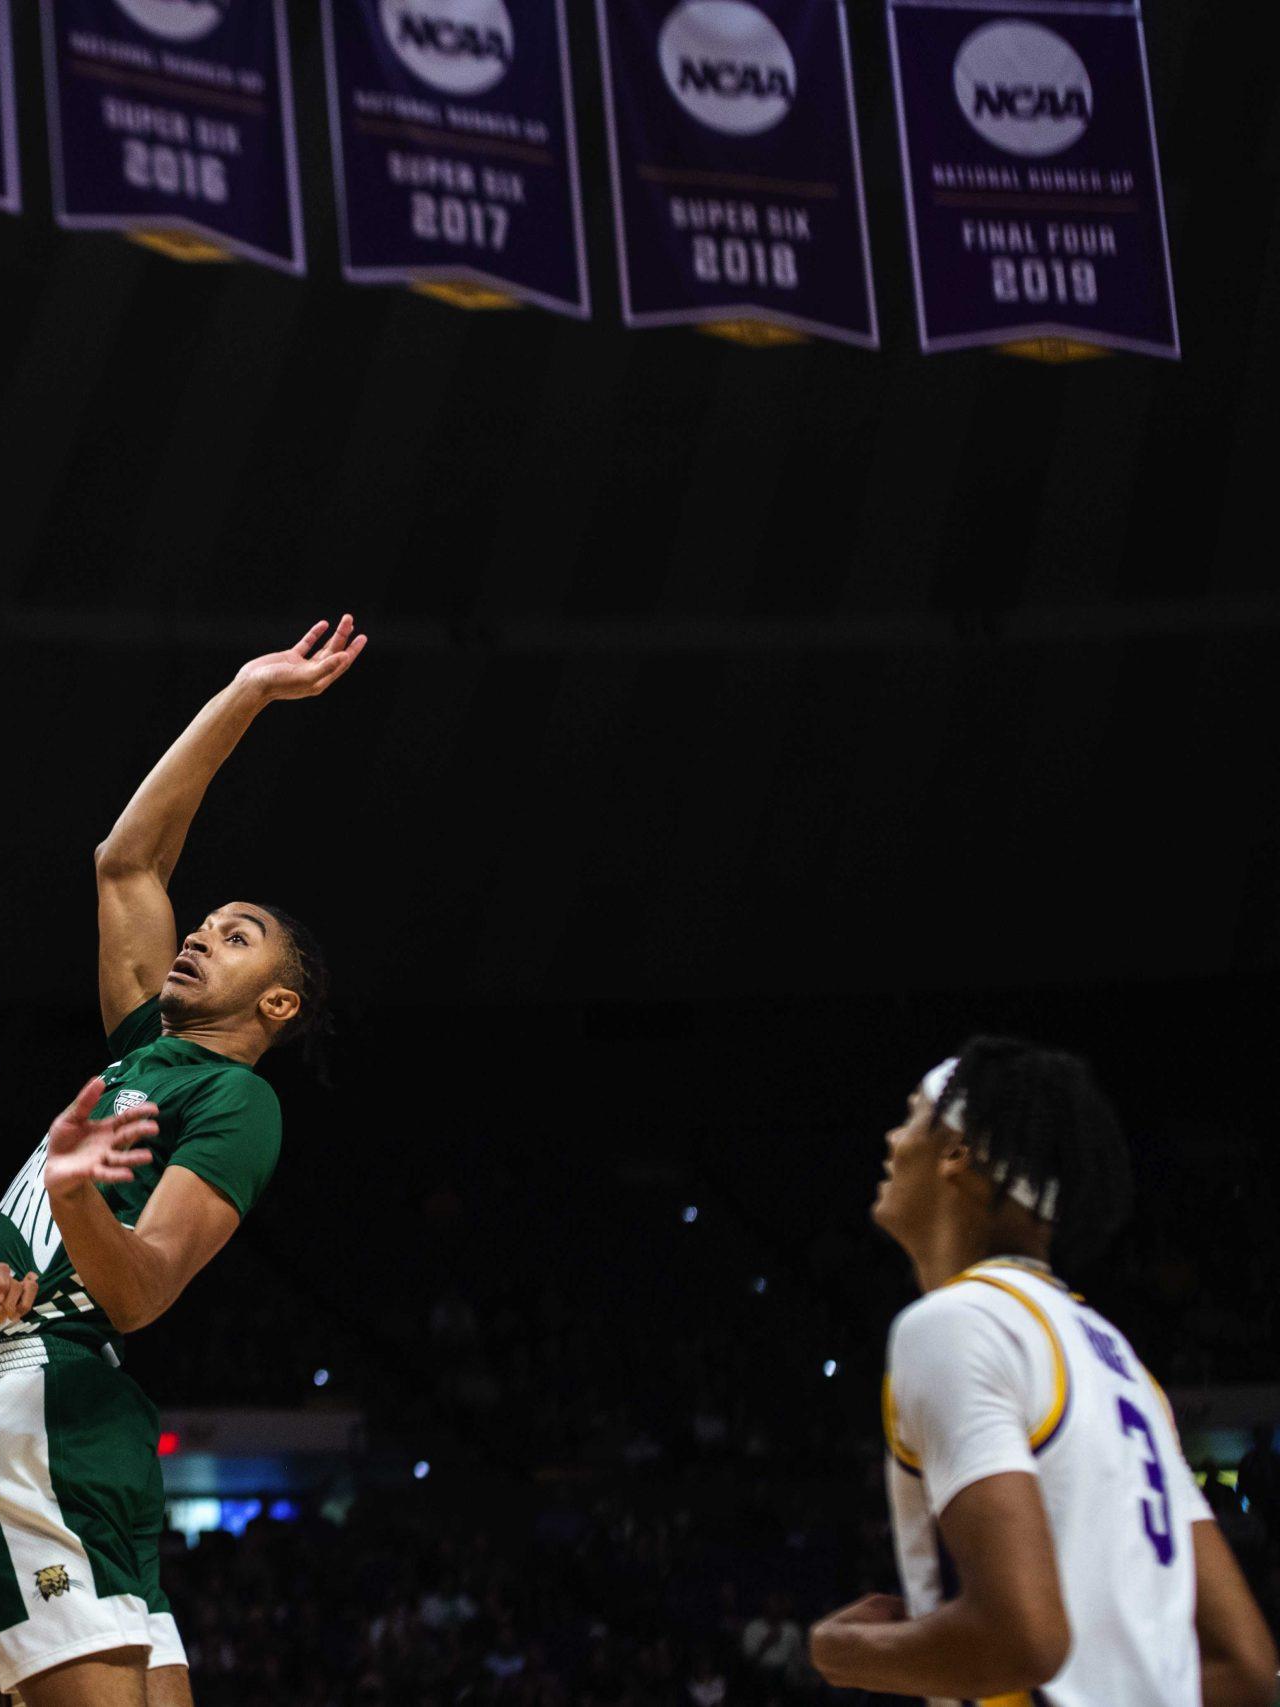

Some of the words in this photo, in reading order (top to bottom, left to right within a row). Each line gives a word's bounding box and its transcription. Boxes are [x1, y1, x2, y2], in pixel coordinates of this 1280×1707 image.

[679, 54, 797, 106] NCAA
[974, 80, 1093, 124] NCAA
[410, 189, 510, 254] 2017
[671, 195, 759, 234] SUPER
[765, 203, 811, 243] SIX
[962, 218, 1038, 253] FINAL
[1047, 221, 1118, 258] FOUR
[692, 233, 798, 290] 2018
[991, 255, 1098, 305] 2019
[1116, 1396, 1173, 1566] 3
